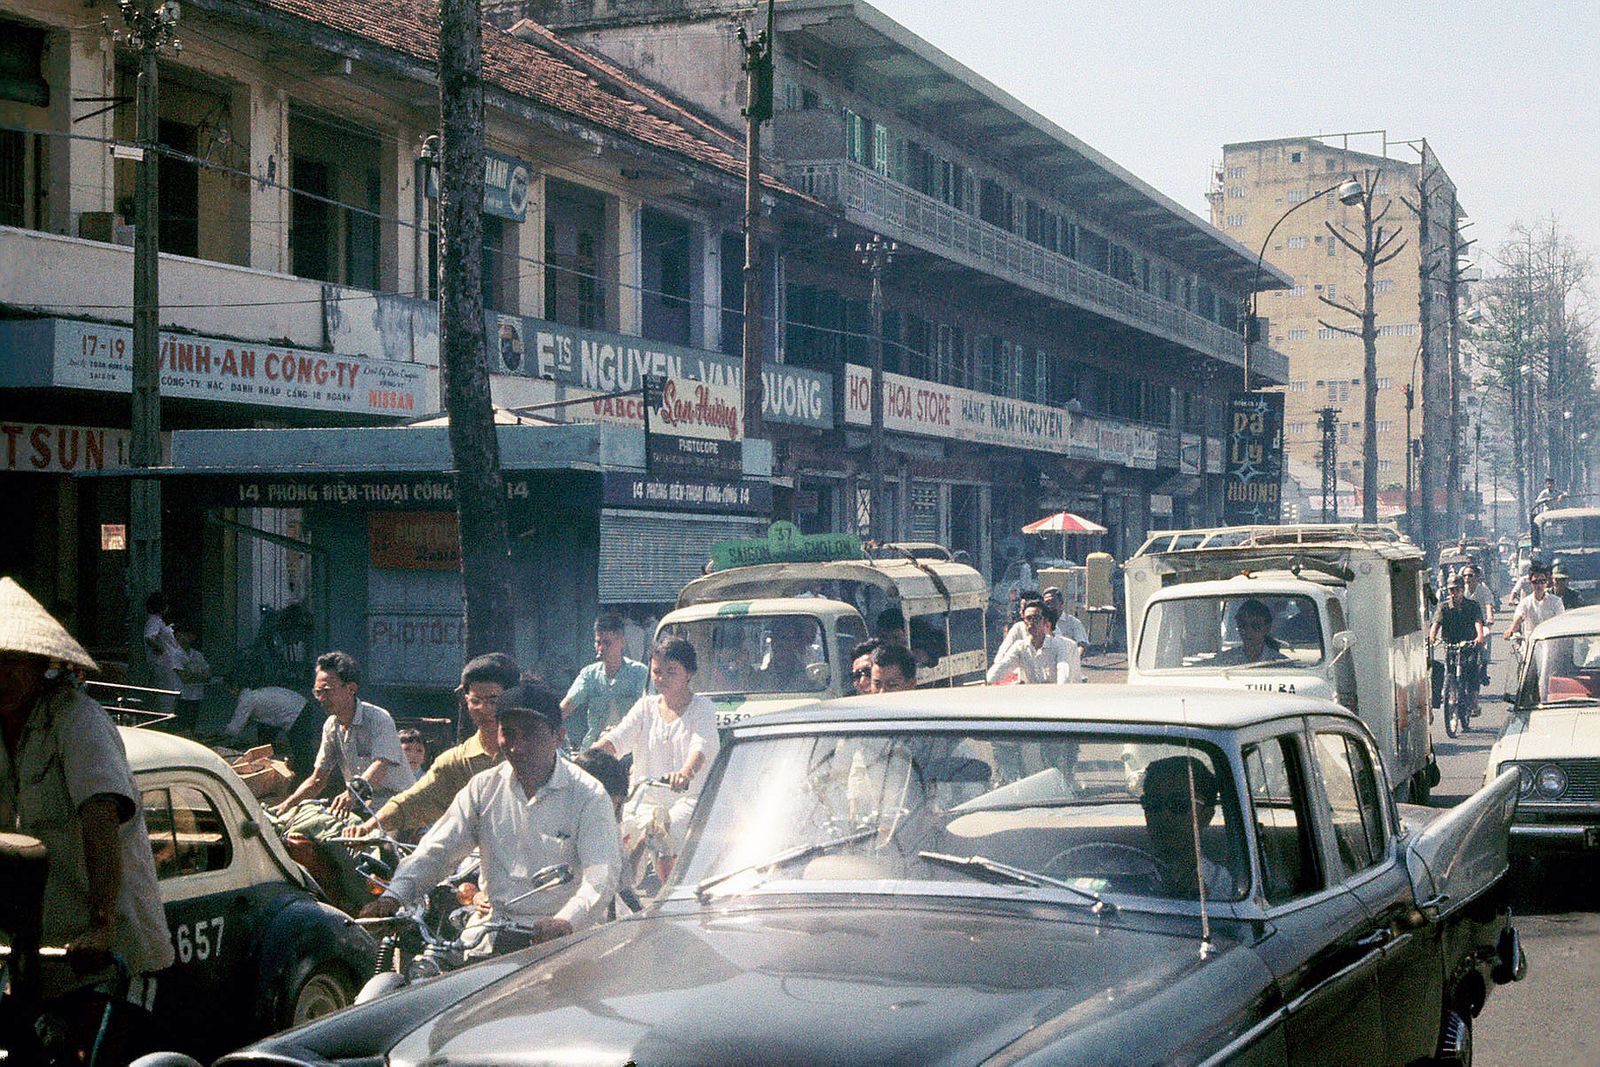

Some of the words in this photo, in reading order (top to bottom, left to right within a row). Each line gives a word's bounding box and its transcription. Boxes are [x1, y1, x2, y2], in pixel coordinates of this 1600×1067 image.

[368, 389, 414, 410] NISSAN
[916, 389, 951, 426] STORE
[239, 483, 260, 500] 14
[507, 481, 529, 500] 14
[774, 527, 793, 541] 37
[176, 916, 225, 964] 657
